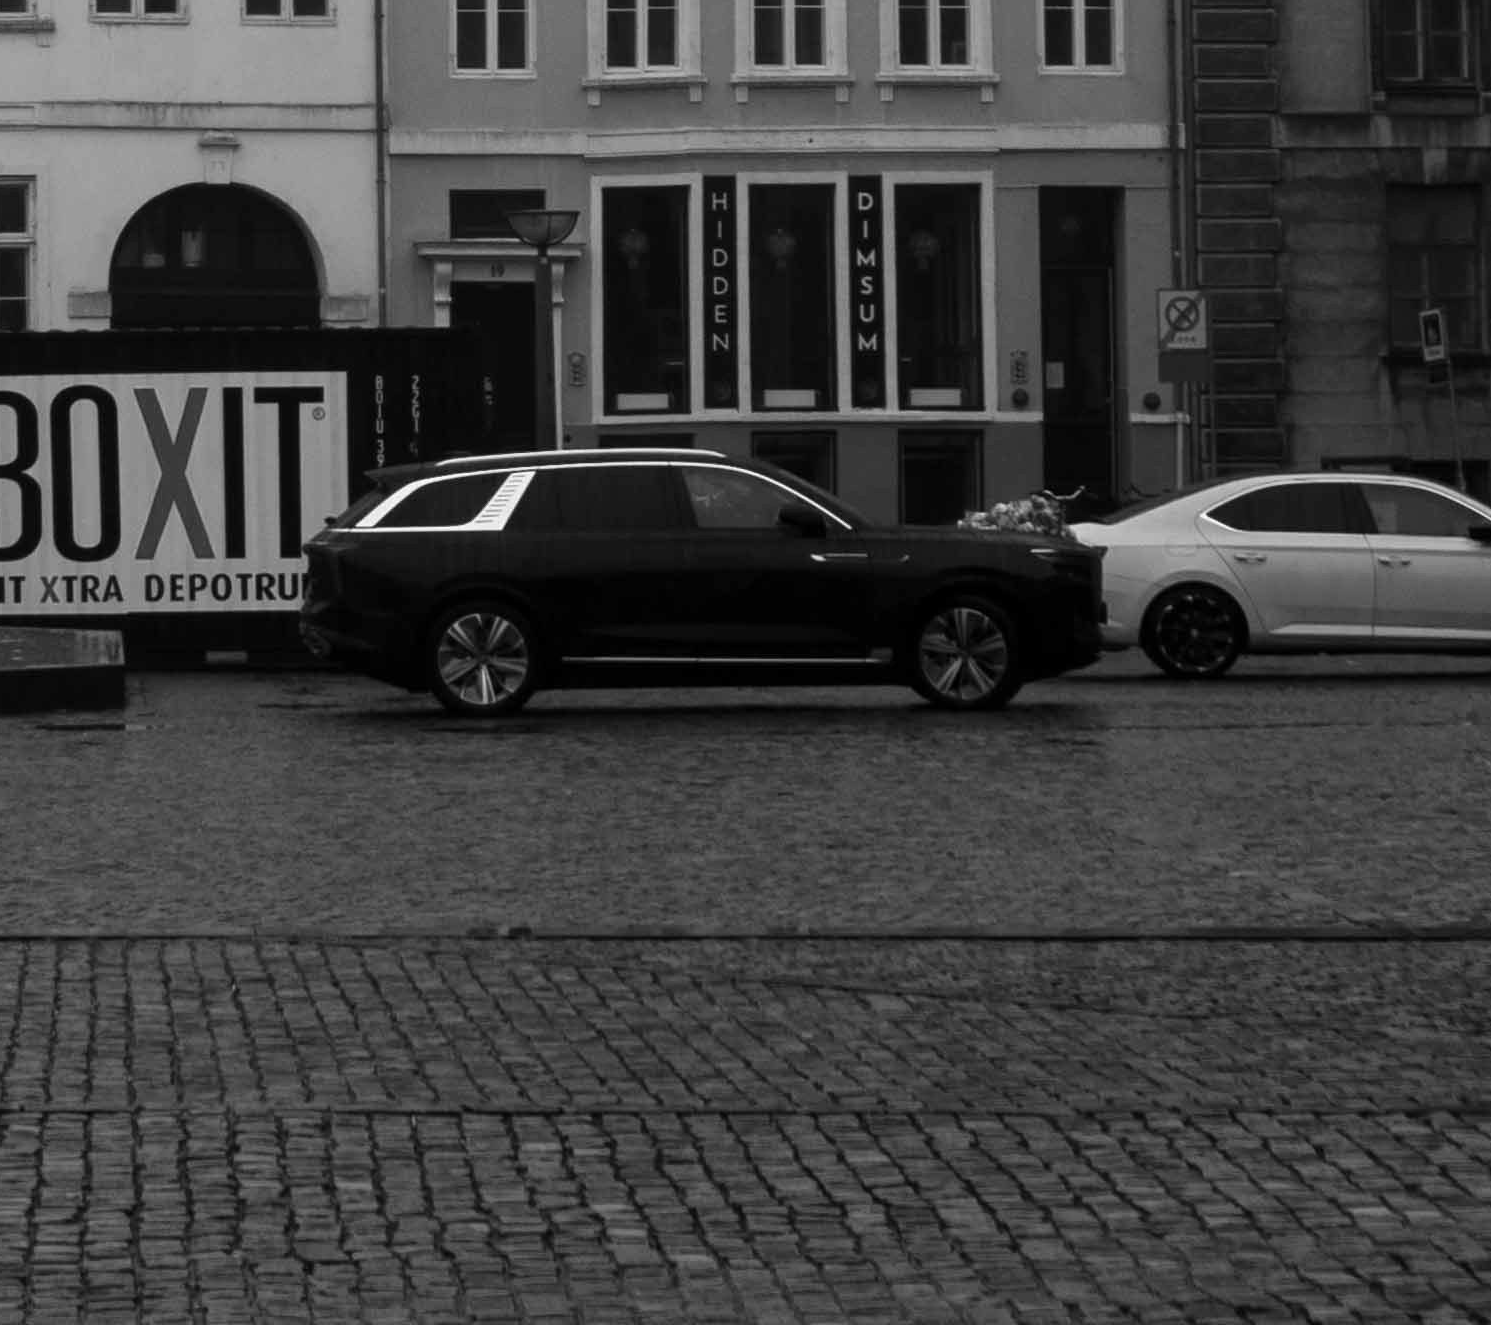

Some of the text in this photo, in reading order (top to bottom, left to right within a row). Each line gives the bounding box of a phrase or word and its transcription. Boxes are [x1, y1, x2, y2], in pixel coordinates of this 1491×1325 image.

[711, 191, 730, 352] HIDDEN
[856, 191, 878, 352] DIMSUM
[40, 574, 123, 604] XTRA
[144, 573, 309, 603] DEPOTRU
